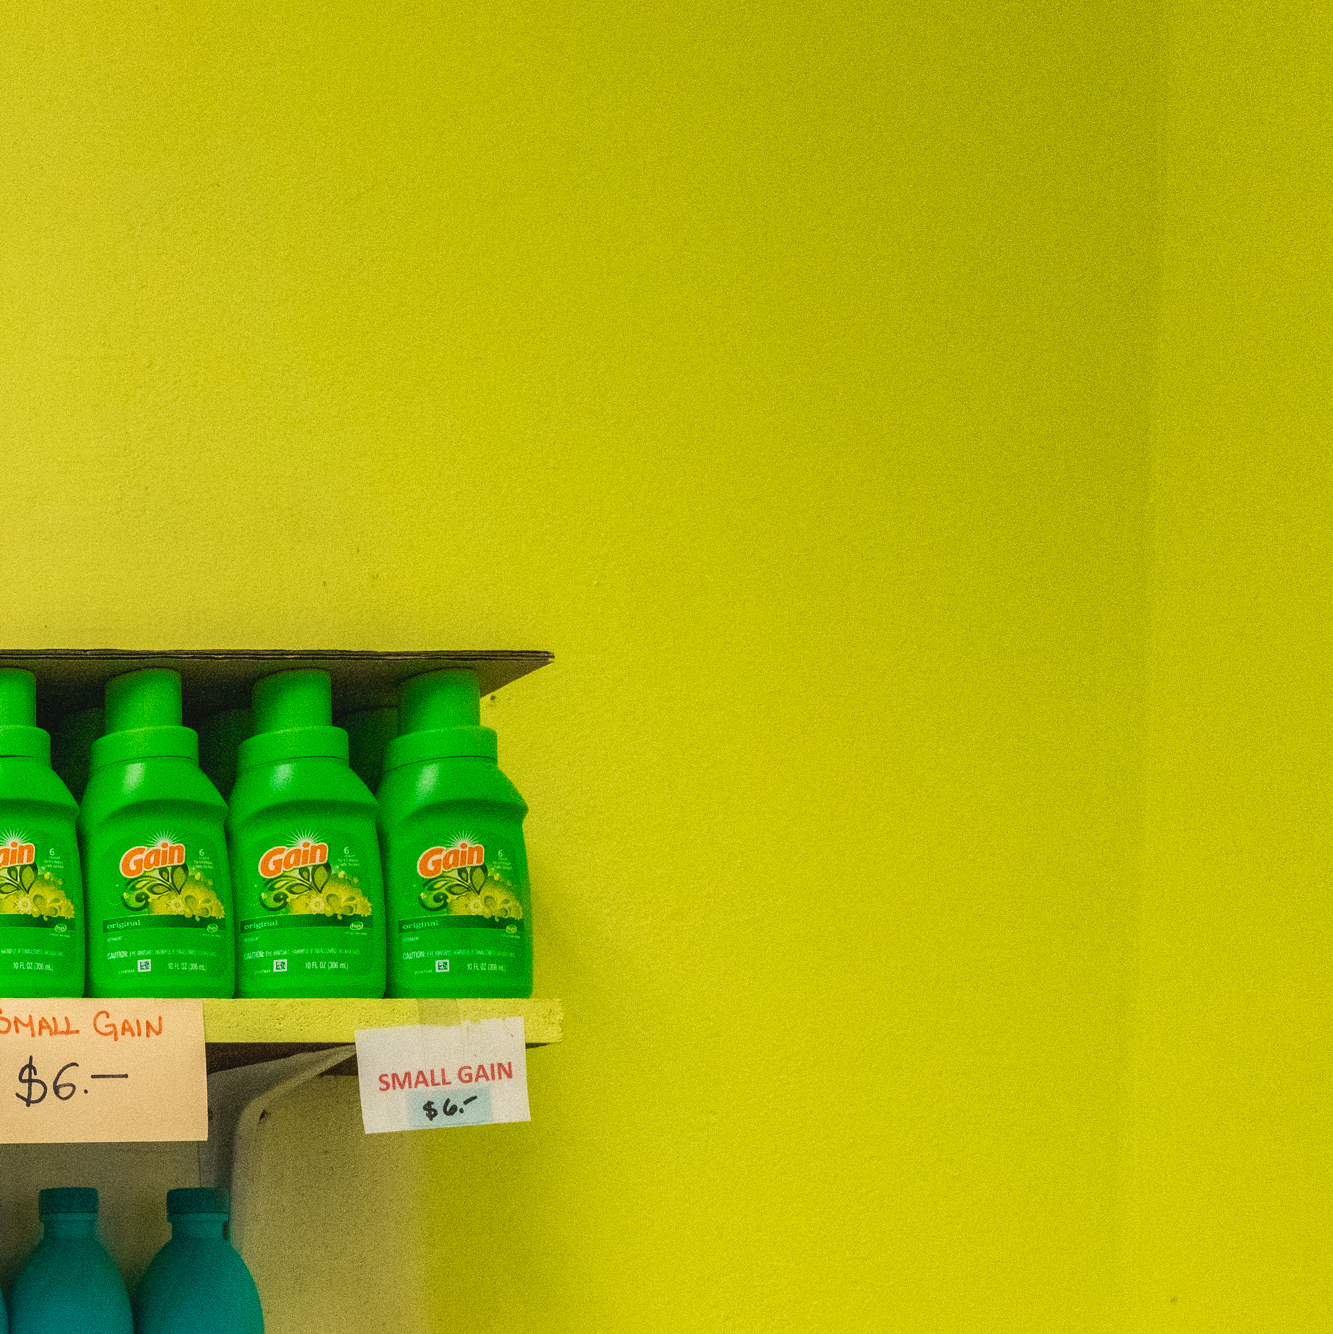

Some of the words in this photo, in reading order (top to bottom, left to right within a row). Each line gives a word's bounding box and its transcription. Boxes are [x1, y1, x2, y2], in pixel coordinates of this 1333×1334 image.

[258, 841, 329, 879] Gain
[243, 919, 278, 929] original
[93, 1010, 163, 1042] GAIN
[377, 1068, 452, 1092] SMALL
[457, 1062, 514, 1084] GAIN
